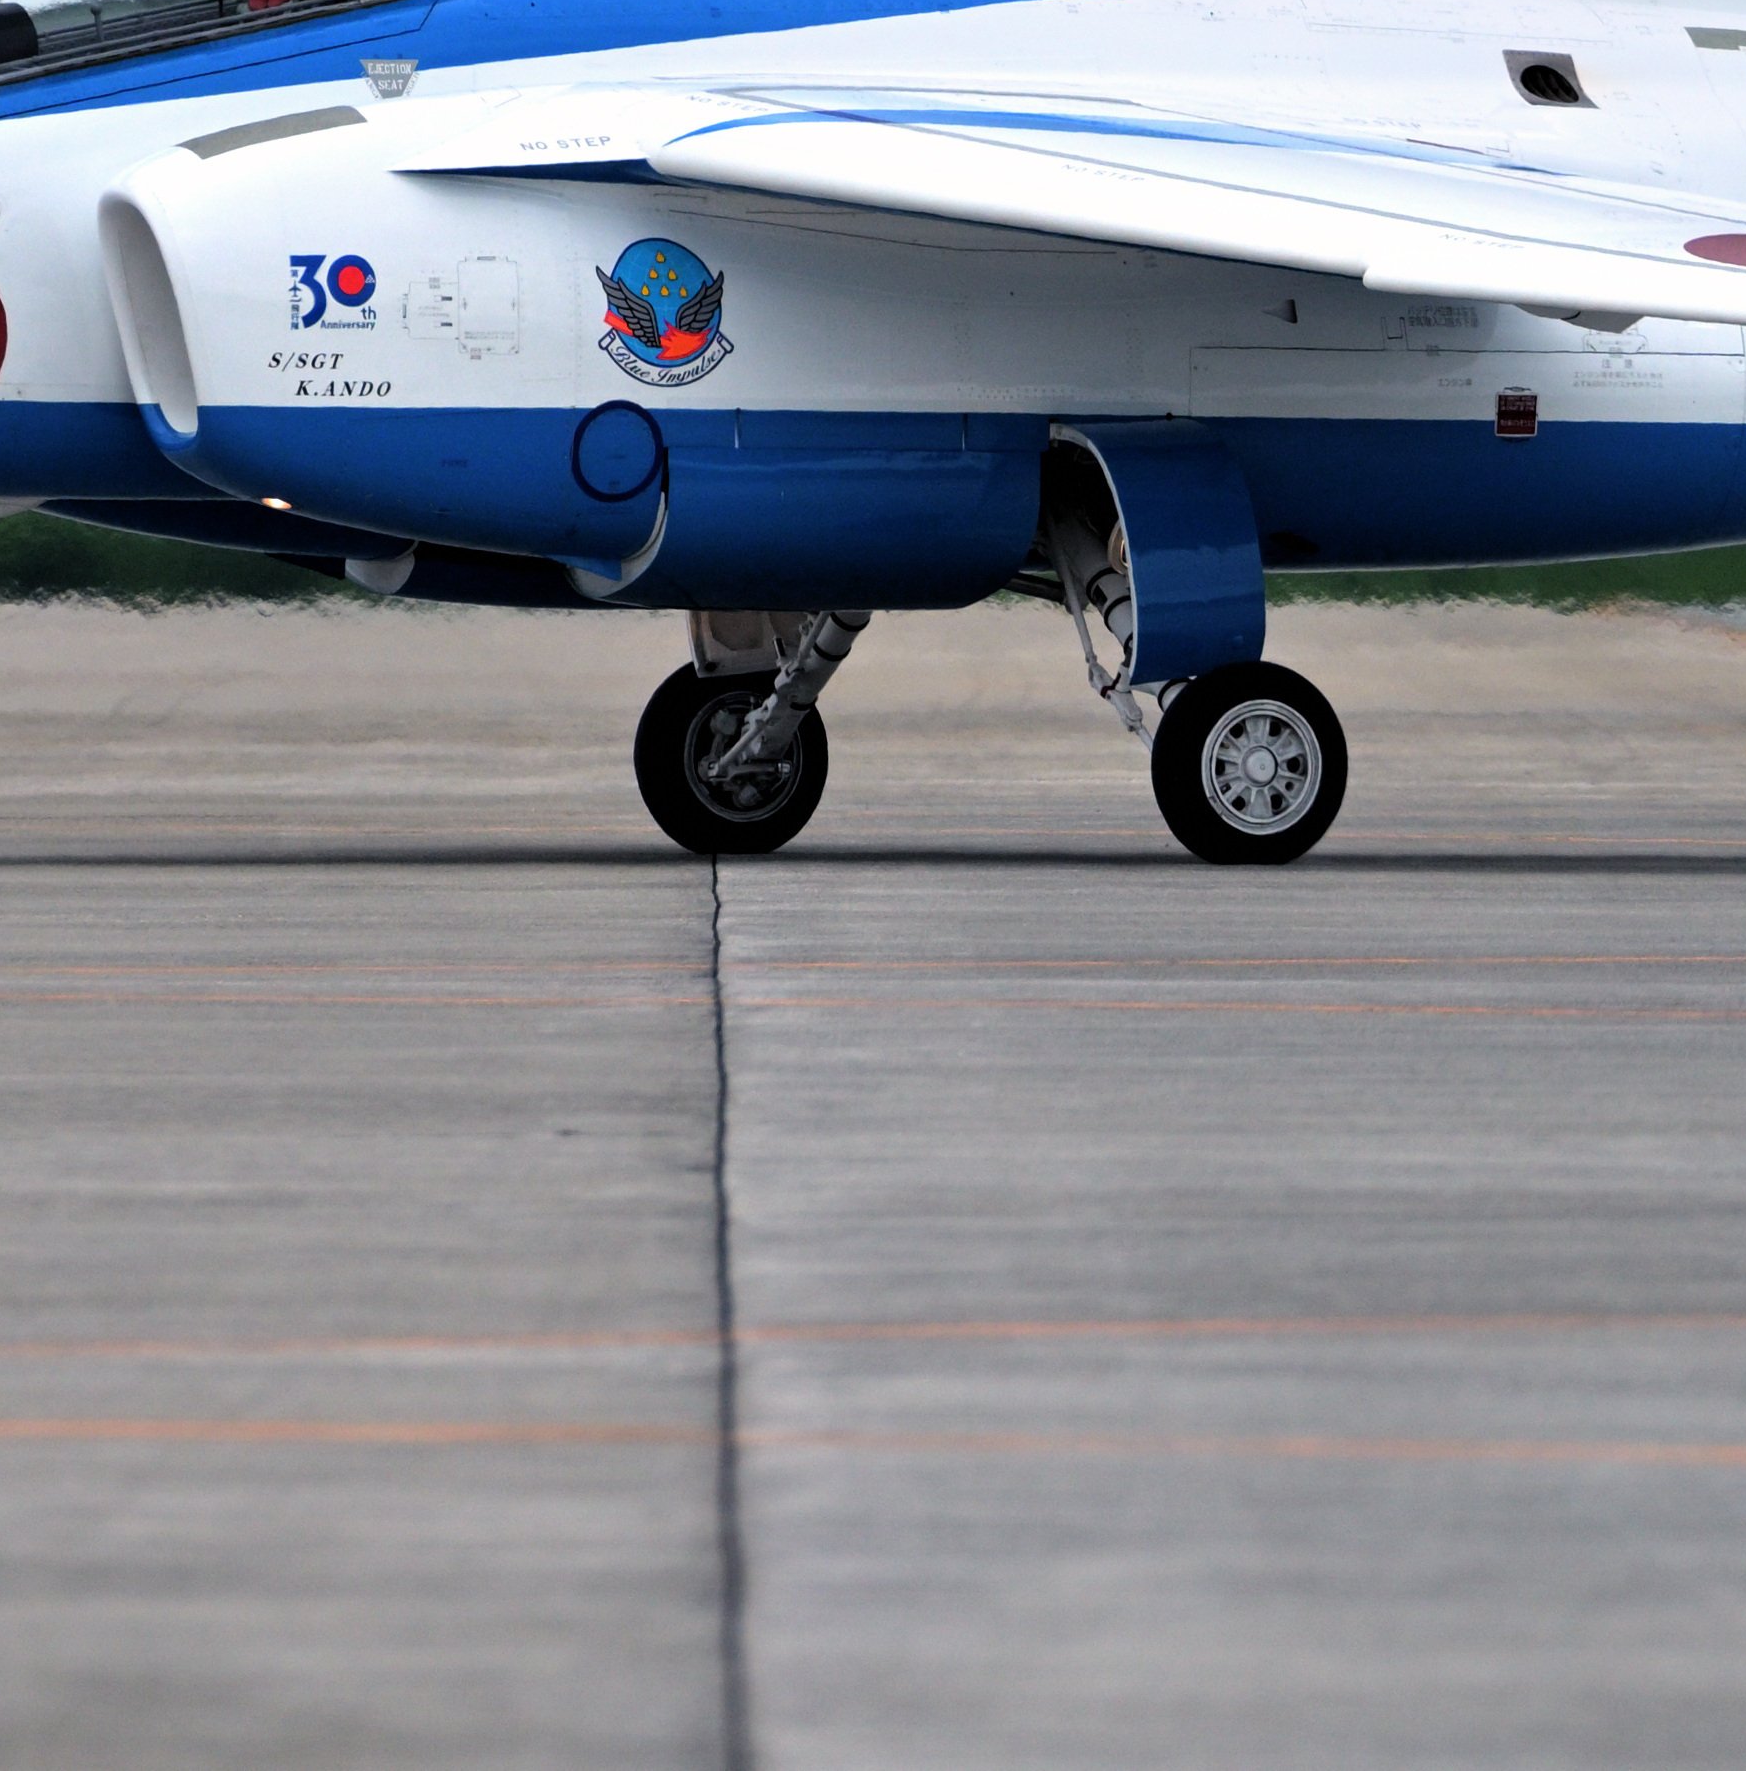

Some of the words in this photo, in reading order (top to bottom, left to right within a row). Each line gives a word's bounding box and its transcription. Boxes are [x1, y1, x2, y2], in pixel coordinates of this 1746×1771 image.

[367, 63, 412, 75] EJECTION
[378, 79, 404, 91] SEAT
[520, 141, 548, 151] NO
[556, 136, 611, 150] STEP
[289, 254, 377, 328] 30
[361, 306, 377, 320] th
[320, 319, 376, 331] Anniversary
[268, 351, 344, 372] S/SGT
[611, 345, 651, 378] Blue
[651, 348, 722, 384] Impulse
[294, 380, 392, 397] K.ANDO
